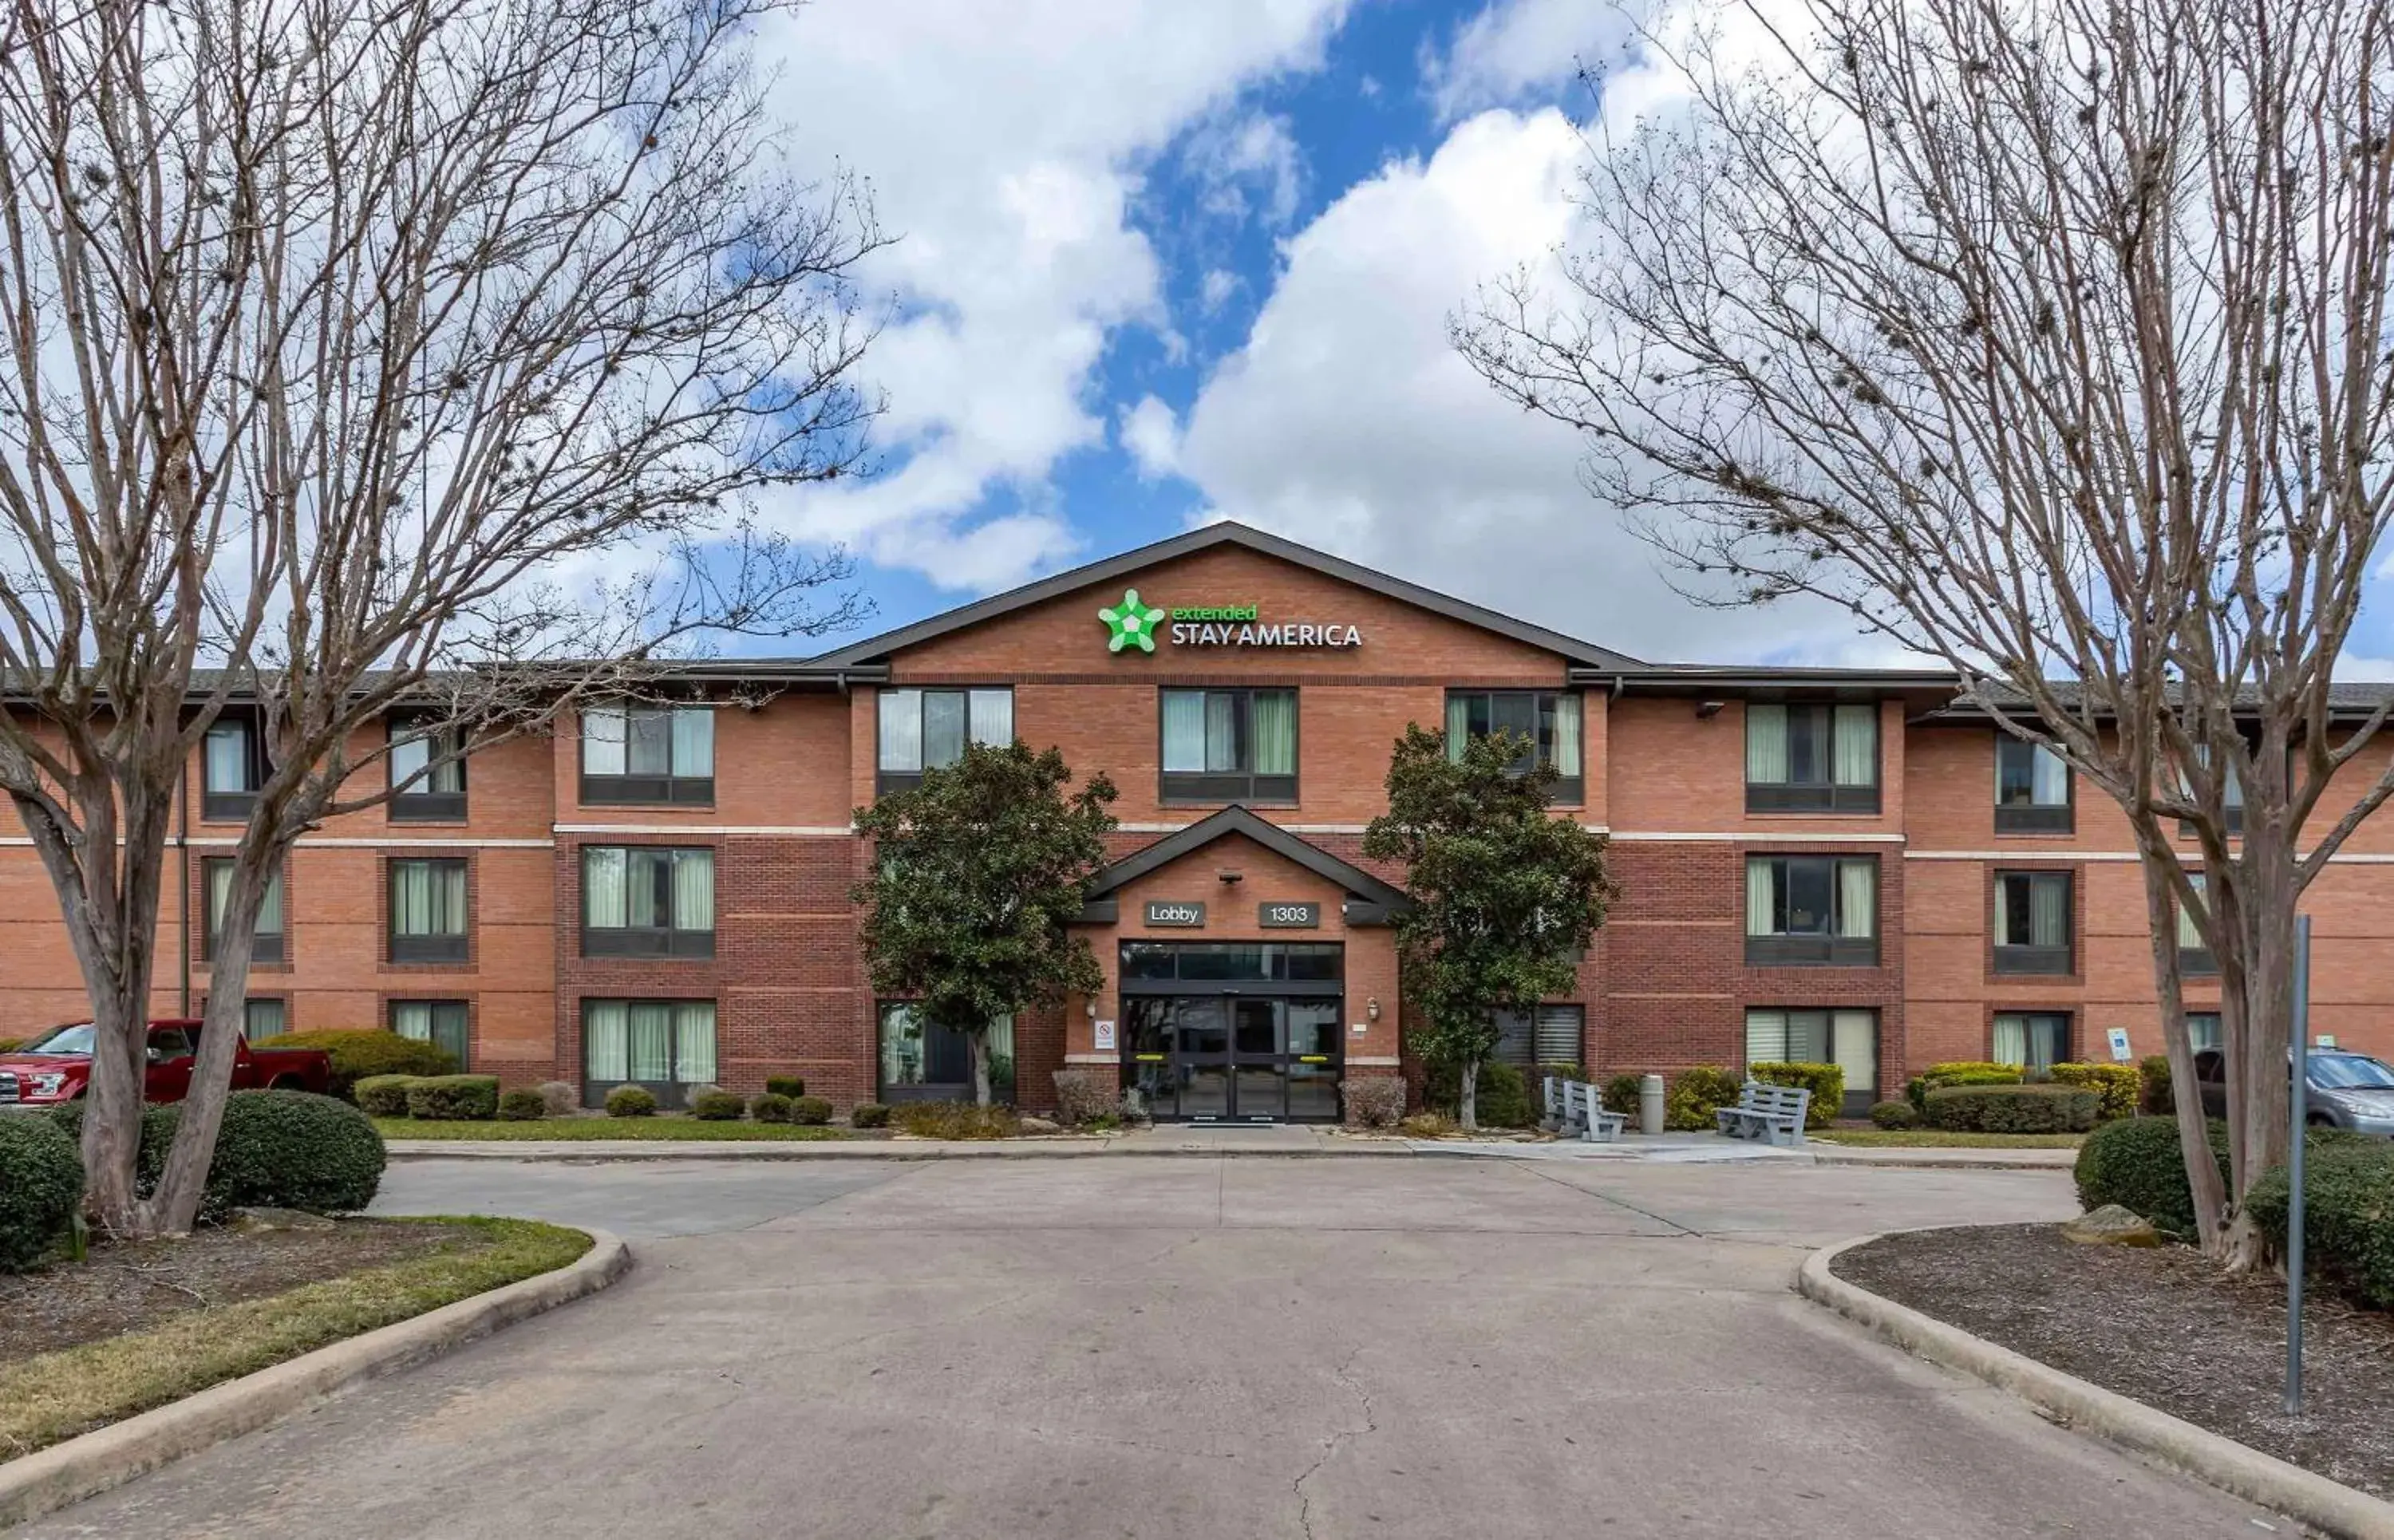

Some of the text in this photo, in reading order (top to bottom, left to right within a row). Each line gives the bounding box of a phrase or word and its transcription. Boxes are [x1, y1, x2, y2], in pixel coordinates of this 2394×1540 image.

[1172, 604, 1257, 620] extended
[1171, 623, 1361, 646] STAY AMERICA
[1152, 906, 1198, 923] Lobby
[1270, 907, 1308, 922] 1303
